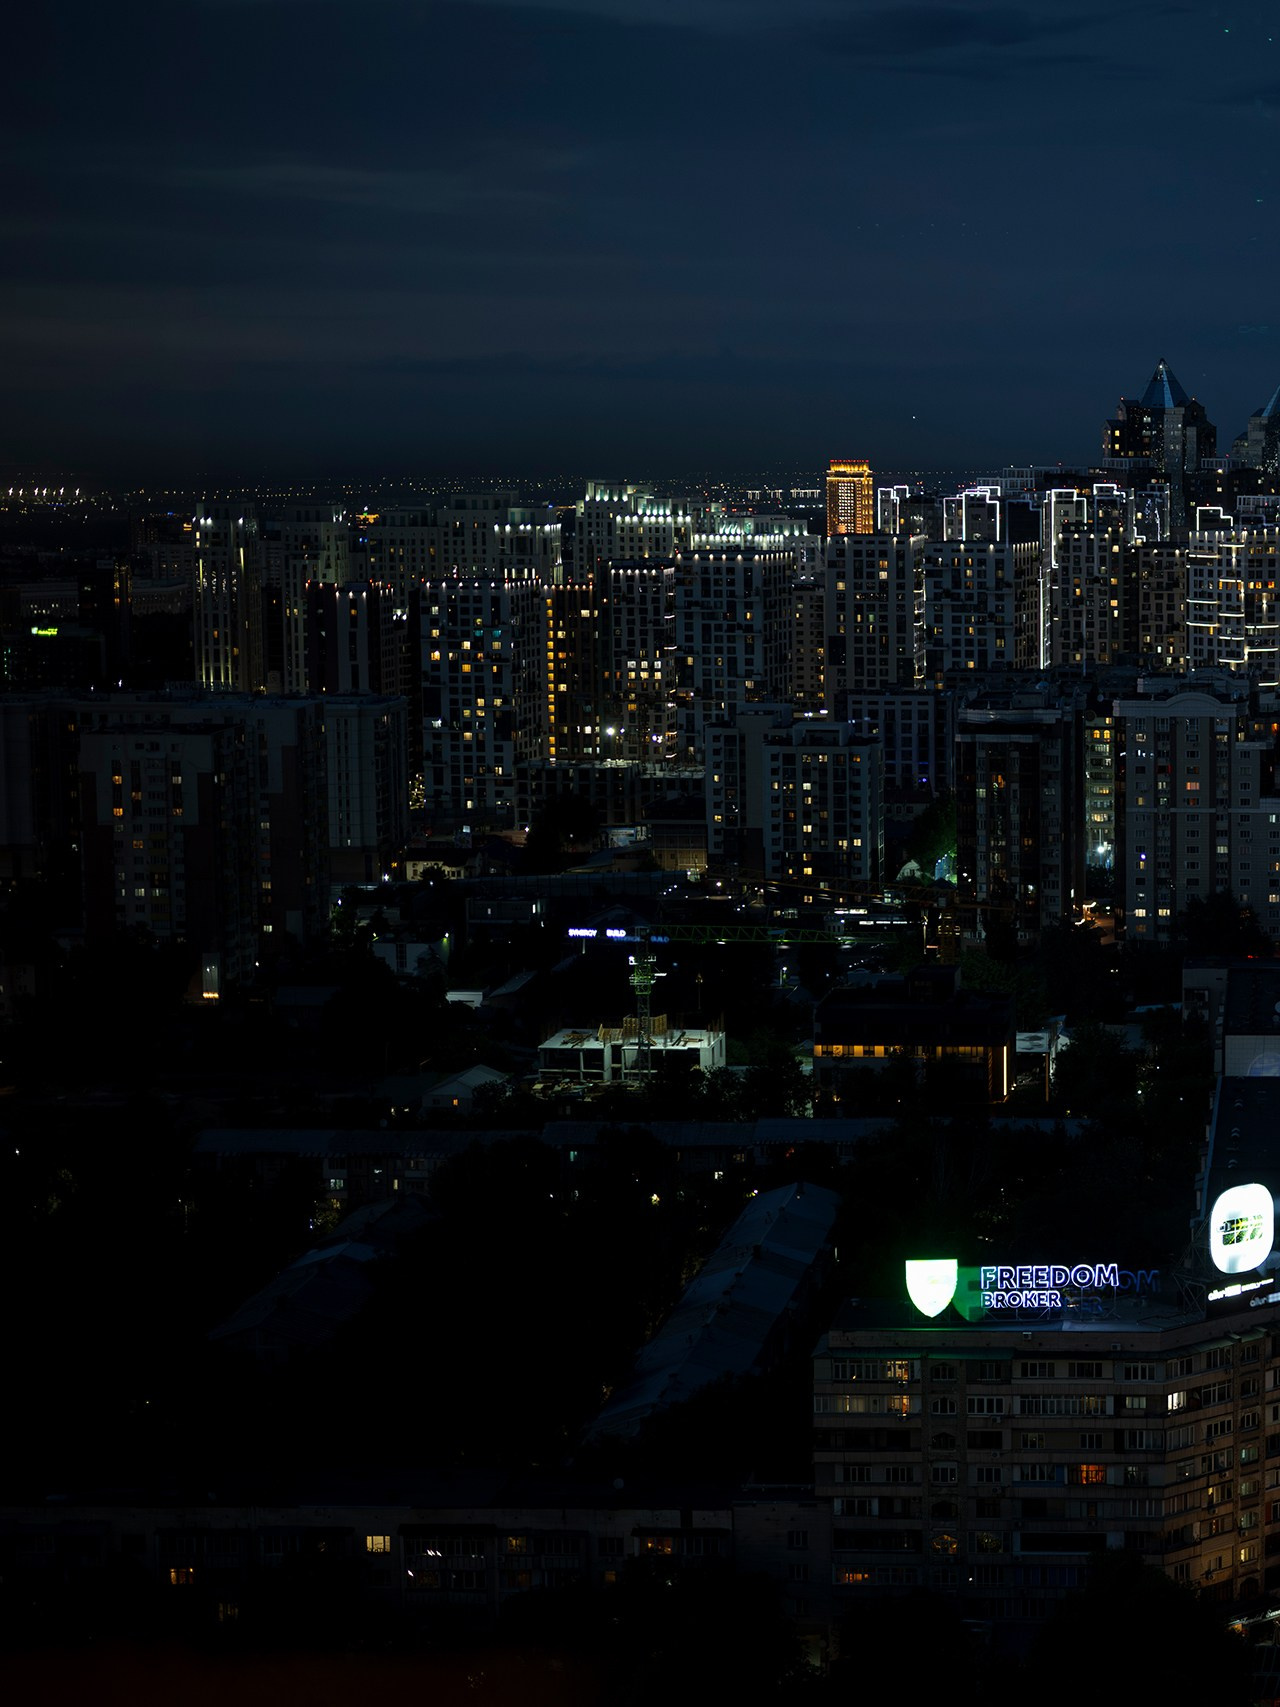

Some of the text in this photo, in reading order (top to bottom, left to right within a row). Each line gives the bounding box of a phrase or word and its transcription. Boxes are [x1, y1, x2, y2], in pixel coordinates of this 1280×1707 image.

[606, 929, 626, 937] BUILD
[980, 1264, 1119, 1289] FREEDOM
[980, 1291, 1061, 1308] BROKER
